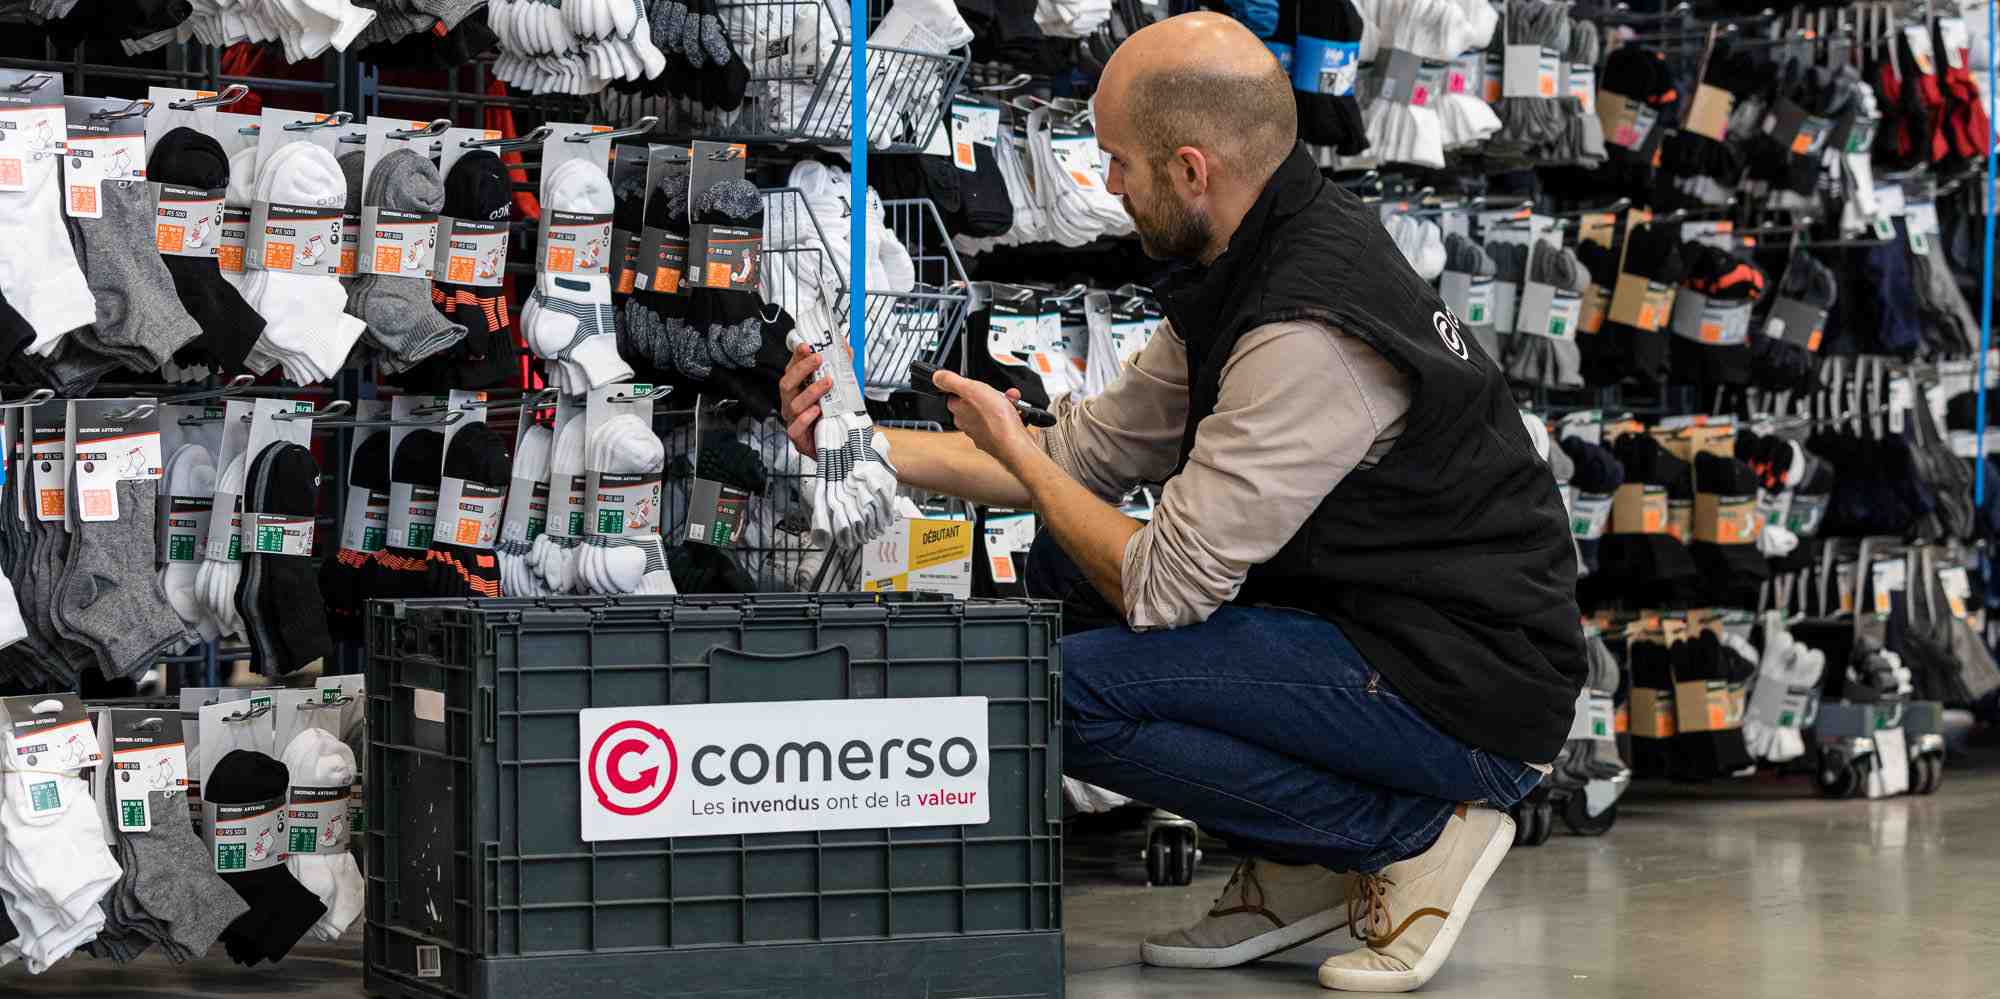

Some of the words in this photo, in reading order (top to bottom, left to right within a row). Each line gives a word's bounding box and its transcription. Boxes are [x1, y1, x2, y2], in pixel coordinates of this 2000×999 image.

[922, 525, 960, 545] DÉBUTANT
[691, 736, 978, 787] comerso
[693, 800, 724, 815] Les
[732, 794, 819, 813] invendus
[827, 794, 858, 809] ont
[865, 792, 888, 808] de
[896, 791, 910, 807] la
[917, 789, 976, 806] valeur
